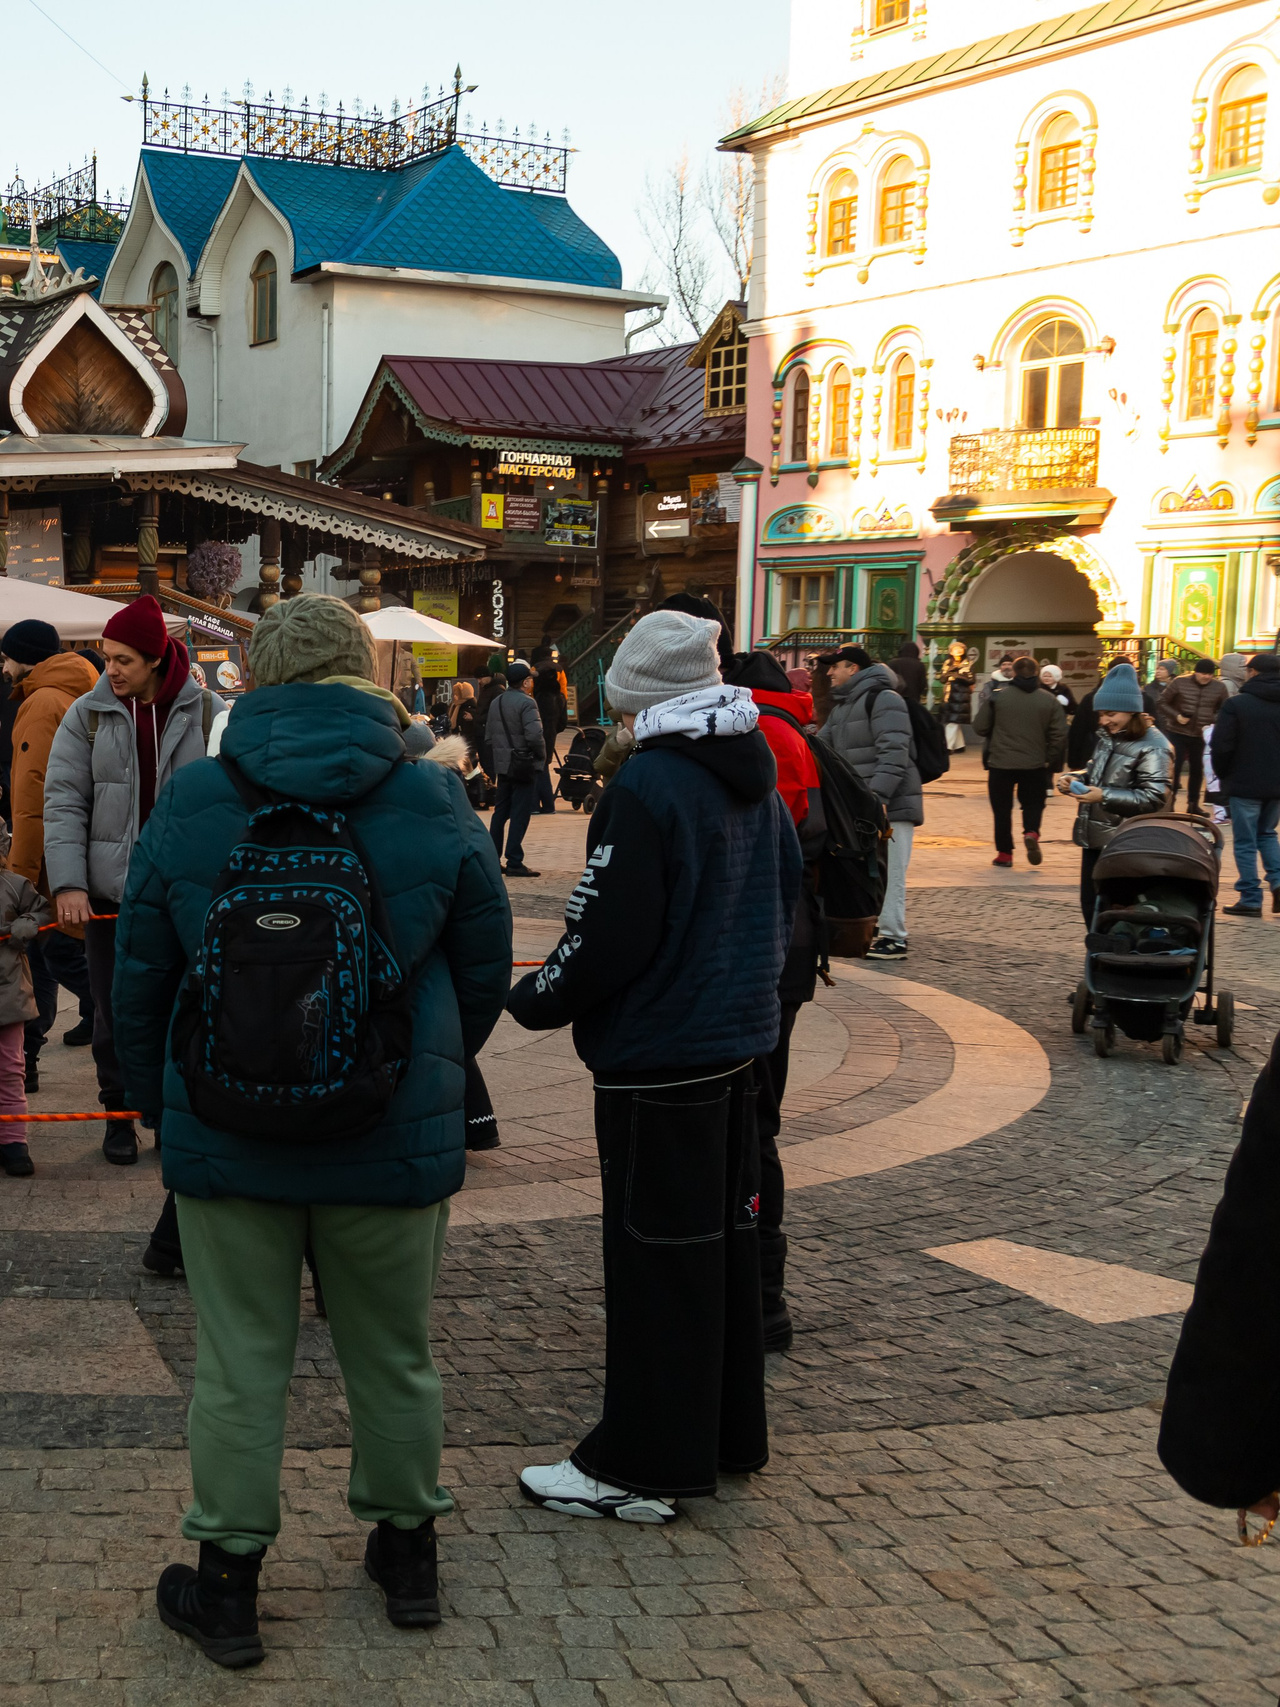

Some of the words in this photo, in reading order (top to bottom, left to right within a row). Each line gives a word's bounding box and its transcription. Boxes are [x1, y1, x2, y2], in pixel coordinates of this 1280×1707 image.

[500, 451, 572, 467] ГОНЧАРНАЯ
[498, 463, 576, 479] МАСТЕРСКАЯ
[492, 579, 504, 638] 2025
[203, 614, 221, 626] КАФЕ
[207, 622, 234, 638] ВЕРАНДА
[201, 651, 227, 660] ПЯН-СЕ
